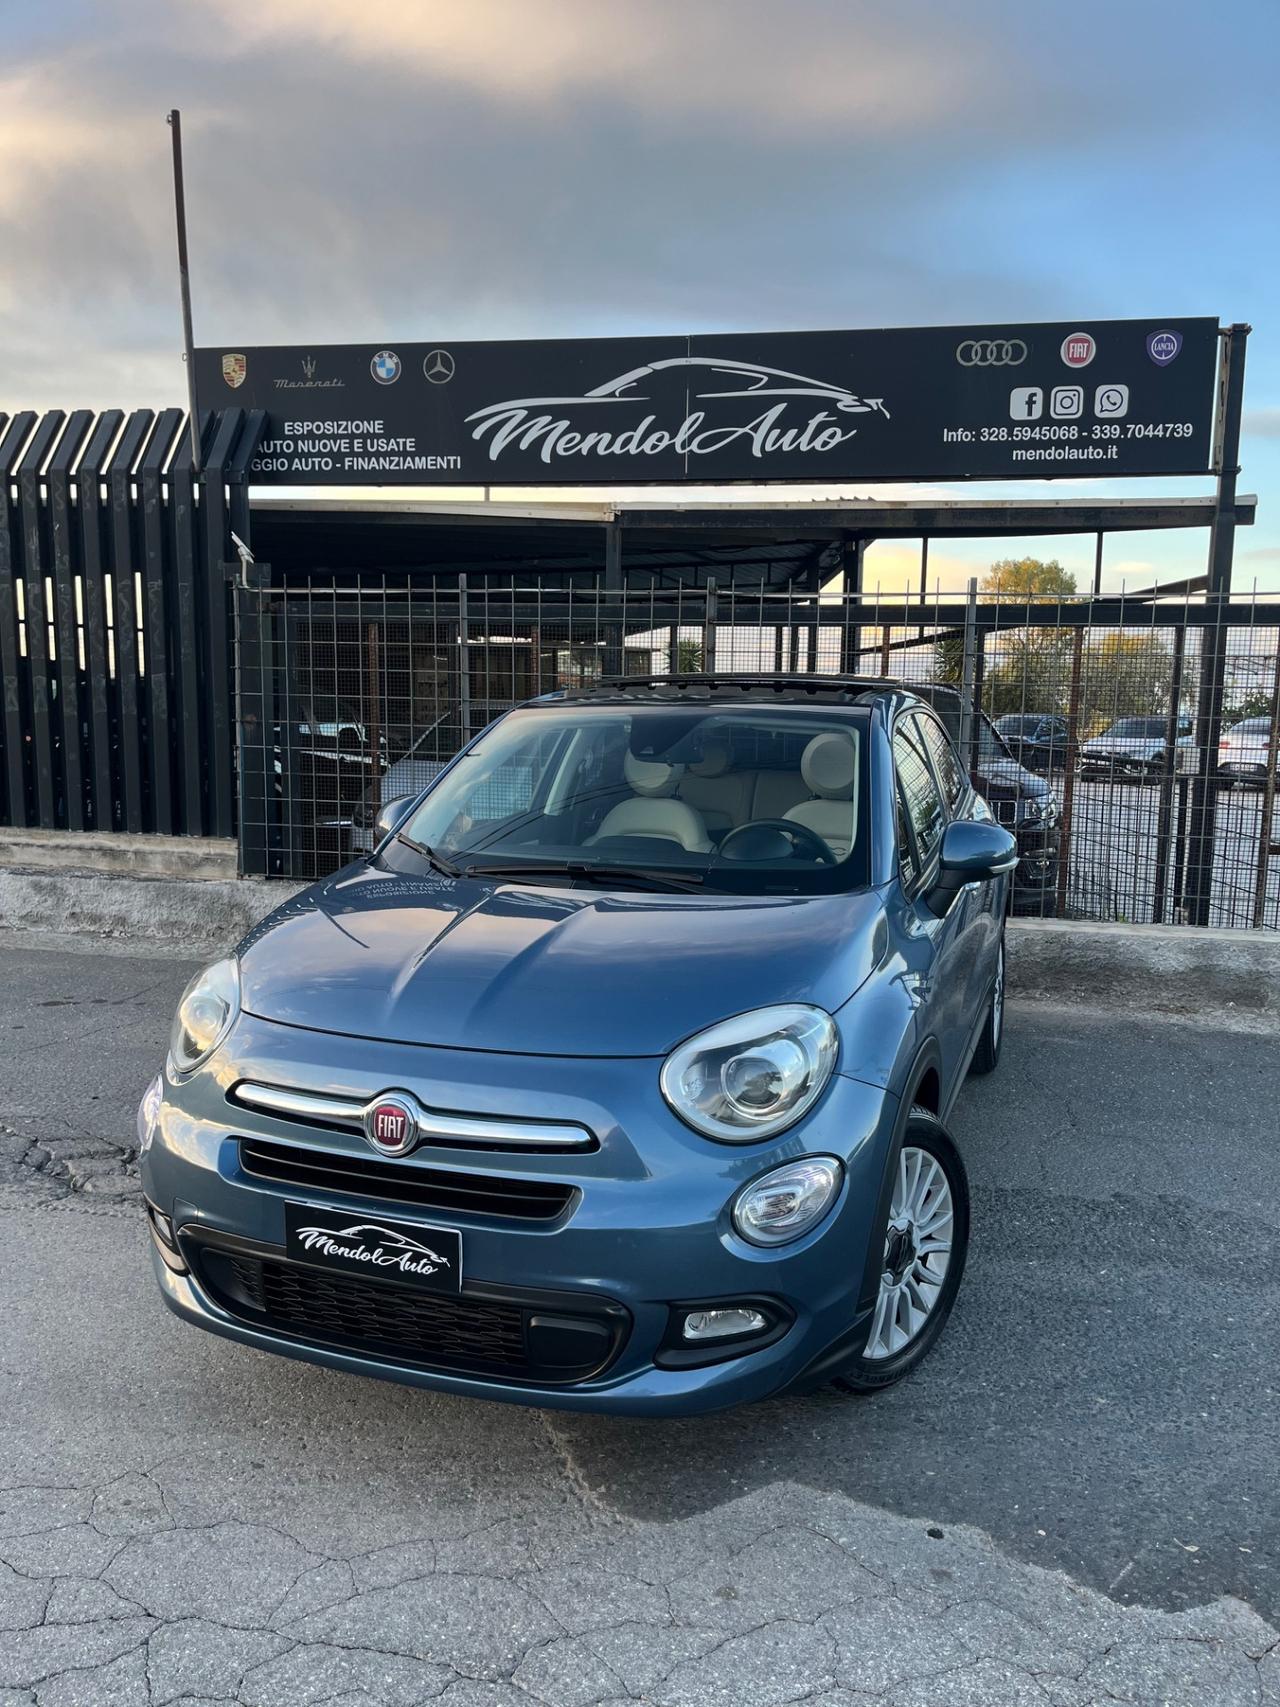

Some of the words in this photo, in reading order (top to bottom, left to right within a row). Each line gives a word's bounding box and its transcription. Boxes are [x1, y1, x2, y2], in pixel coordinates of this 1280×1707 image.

[1068, 342, 1089, 359] FIAT
[1153, 341, 1174, 352] LANCIA
[284, 420, 384, 435] ESPOSIZIONE
[471, 402, 857, 464] MendolAuto
[943, 428, 976, 442] Info:
[980, 426, 1078, 441] 328.5945068
[1091, 423, 1193, 439] 339.7044739
[297, 439, 350, 453] NUOVE
[353, 439, 363, 452] E
[367, 438, 416, 452] USATE
[1012, 445, 1118, 460] mendolauto.it
[251, 458, 288, 471] GGIO
[291, 457, 333, 471] AUTO
[344, 455, 461, 470] FINANZIAMENTI
[377, 1114, 405, 1139] FIAT
[298, 1231, 438, 1275] MendolAuto
